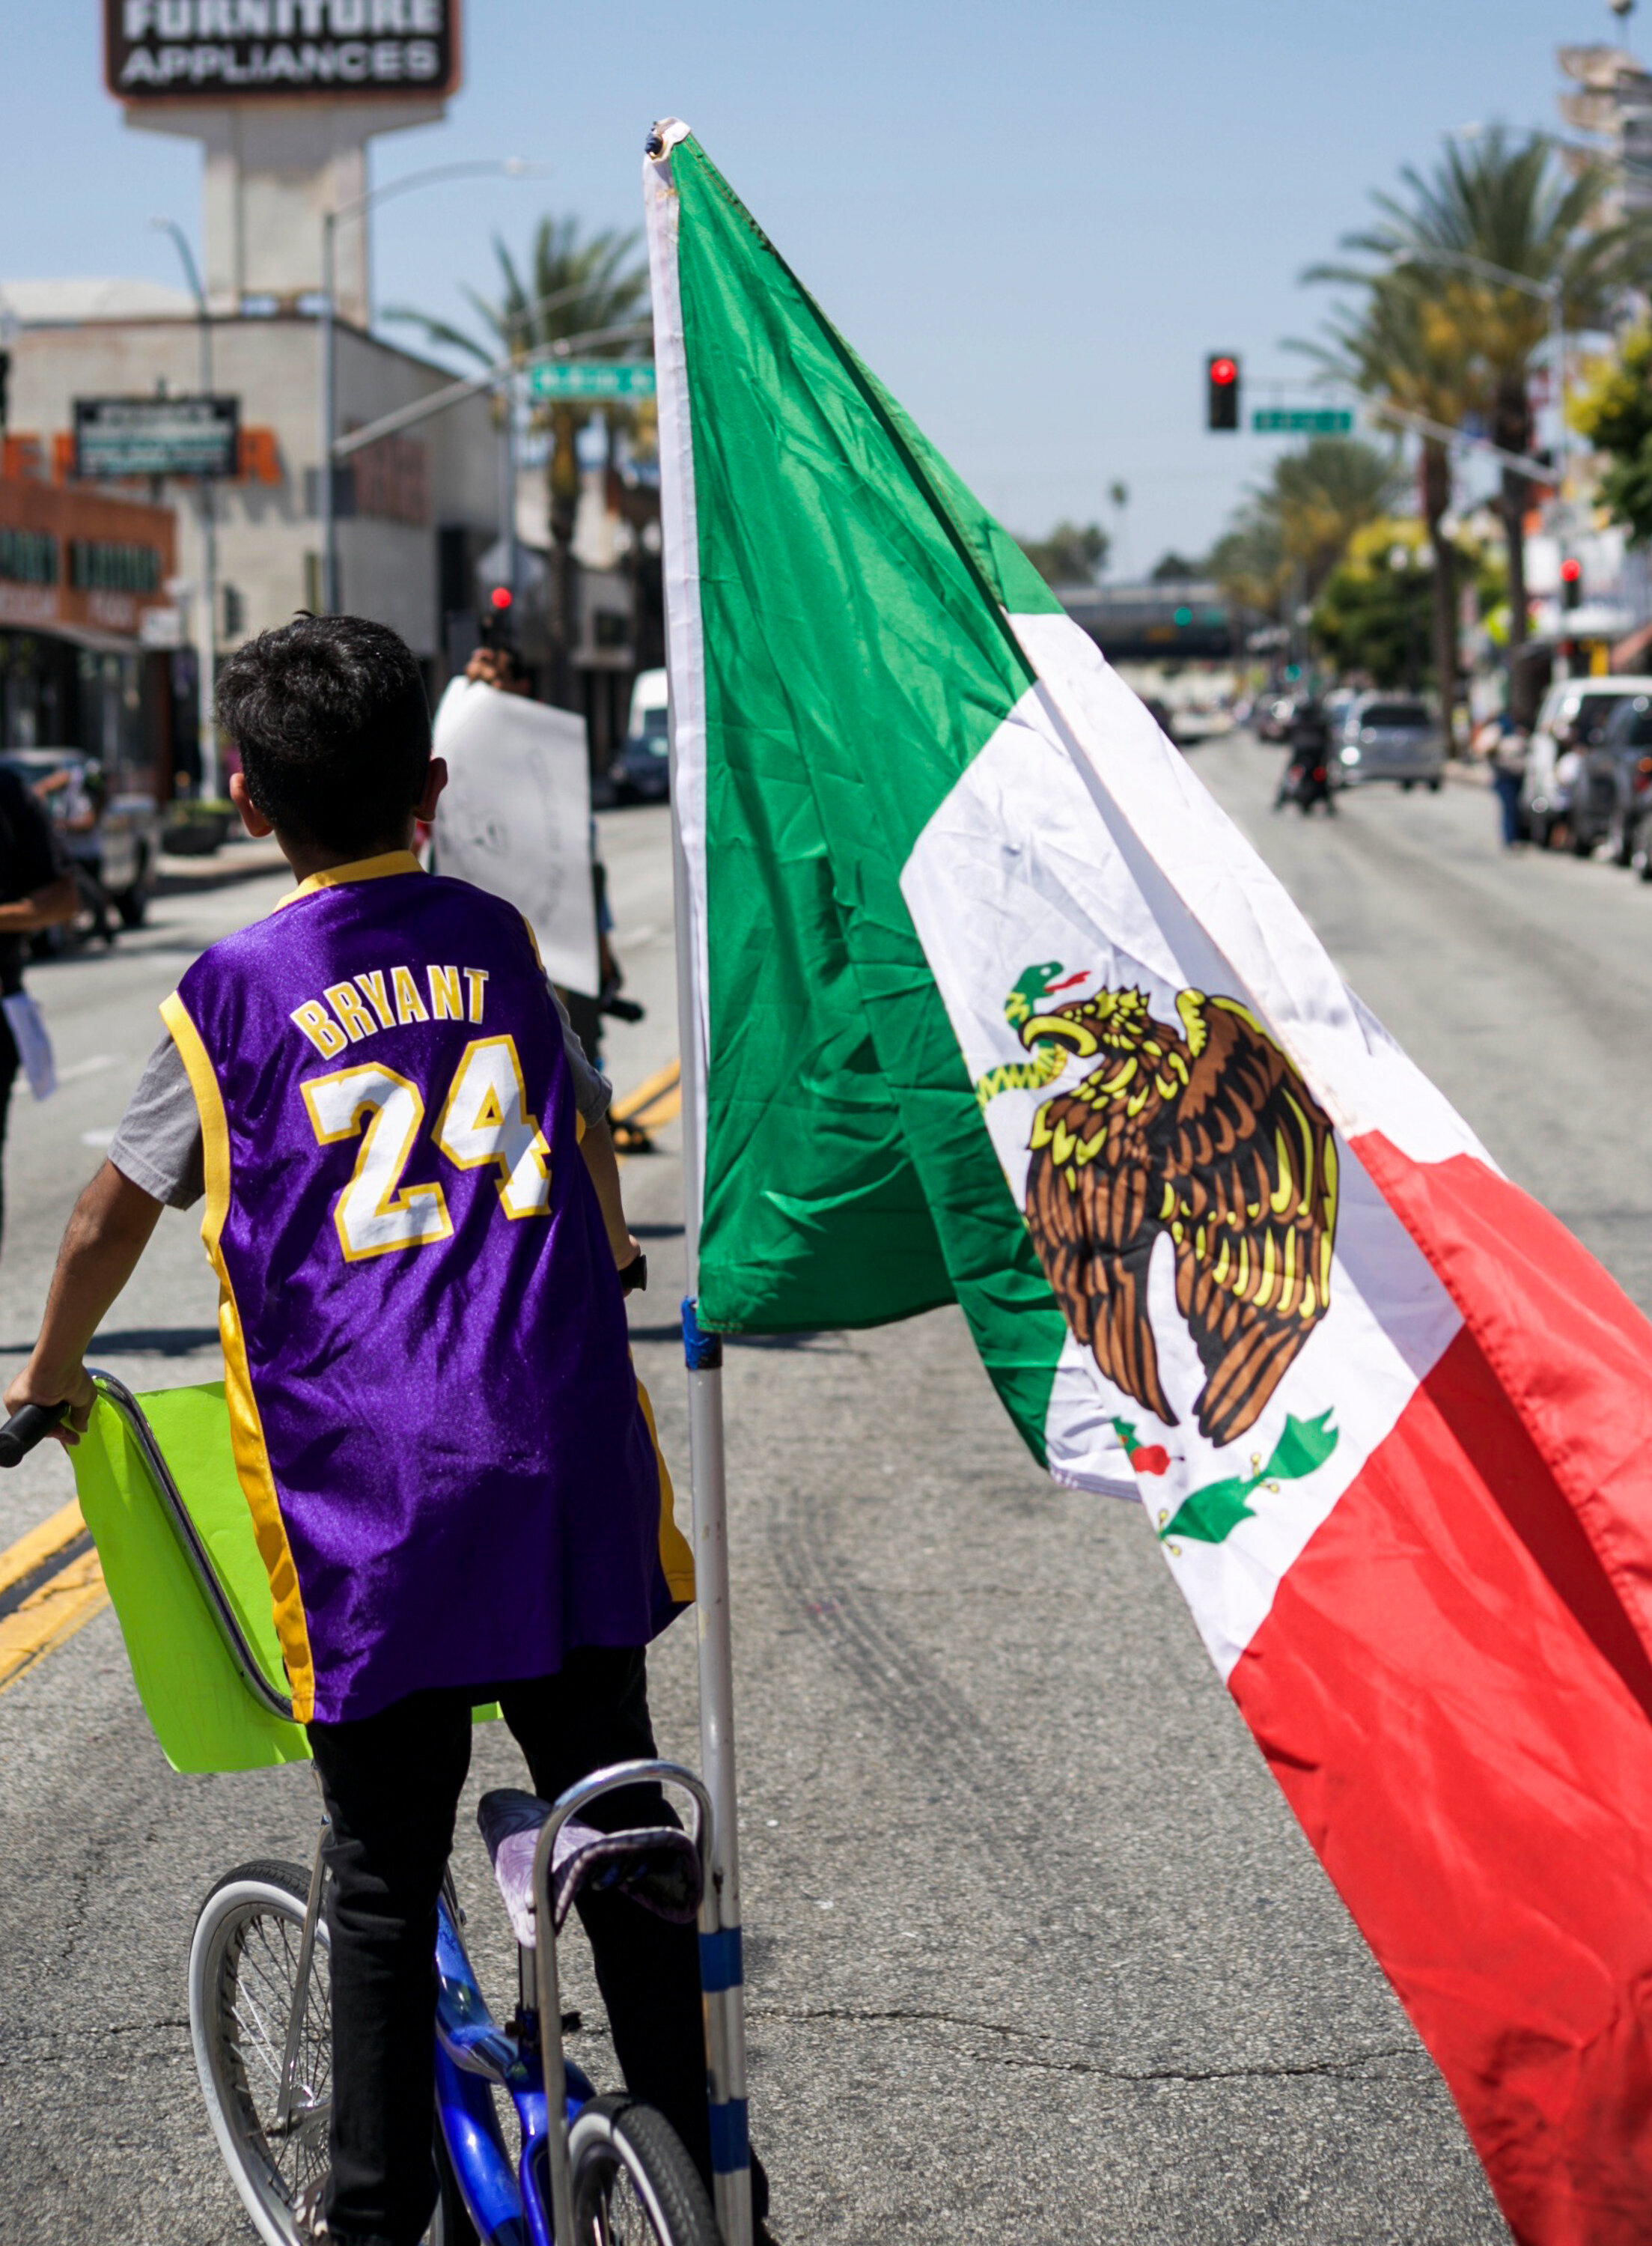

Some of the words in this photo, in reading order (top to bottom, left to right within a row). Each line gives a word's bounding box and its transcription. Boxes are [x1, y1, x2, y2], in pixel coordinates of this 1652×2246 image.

[124, 0, 442, 39] FURNITURE
[120, 40, 439, 85] APPLIANCES
[290, 965, 490, 1060] BRYANT
[300, 1034, 552, 1263] 24
